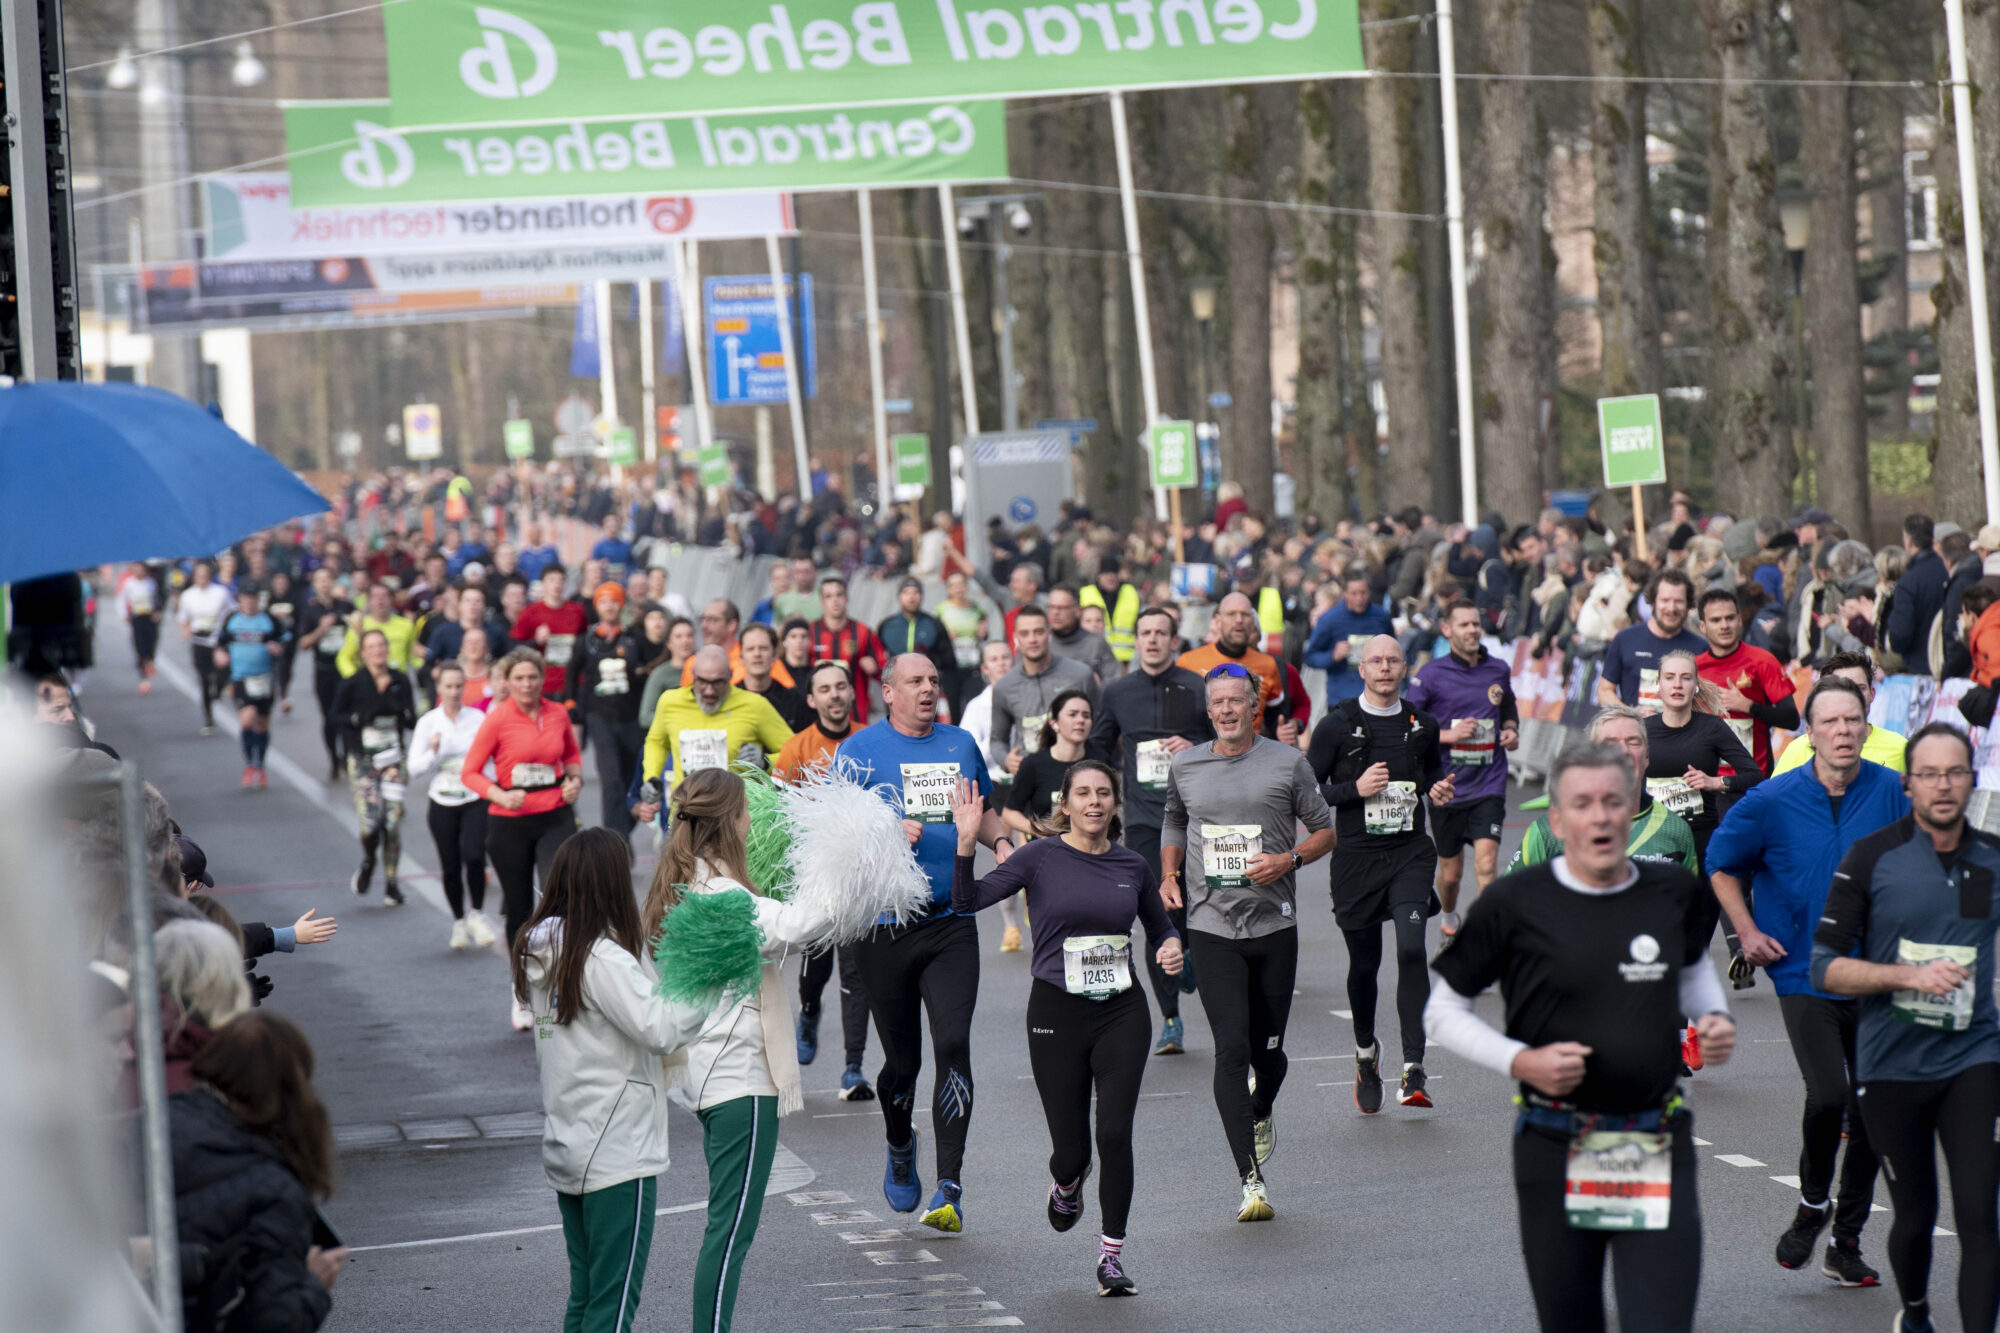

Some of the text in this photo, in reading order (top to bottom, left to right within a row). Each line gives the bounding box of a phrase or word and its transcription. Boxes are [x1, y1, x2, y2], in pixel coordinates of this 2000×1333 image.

[912, 777, 956, 788] WOUTER
[1384, 795, 1402, 805] THEO
[1214, 843, 1248, 853] MAARTEN
[1216, 856, 1248, 870] 11851
[1081, 954, 1114, 966] MARIEKE
[1083, 968, 1115, 985] 12435
